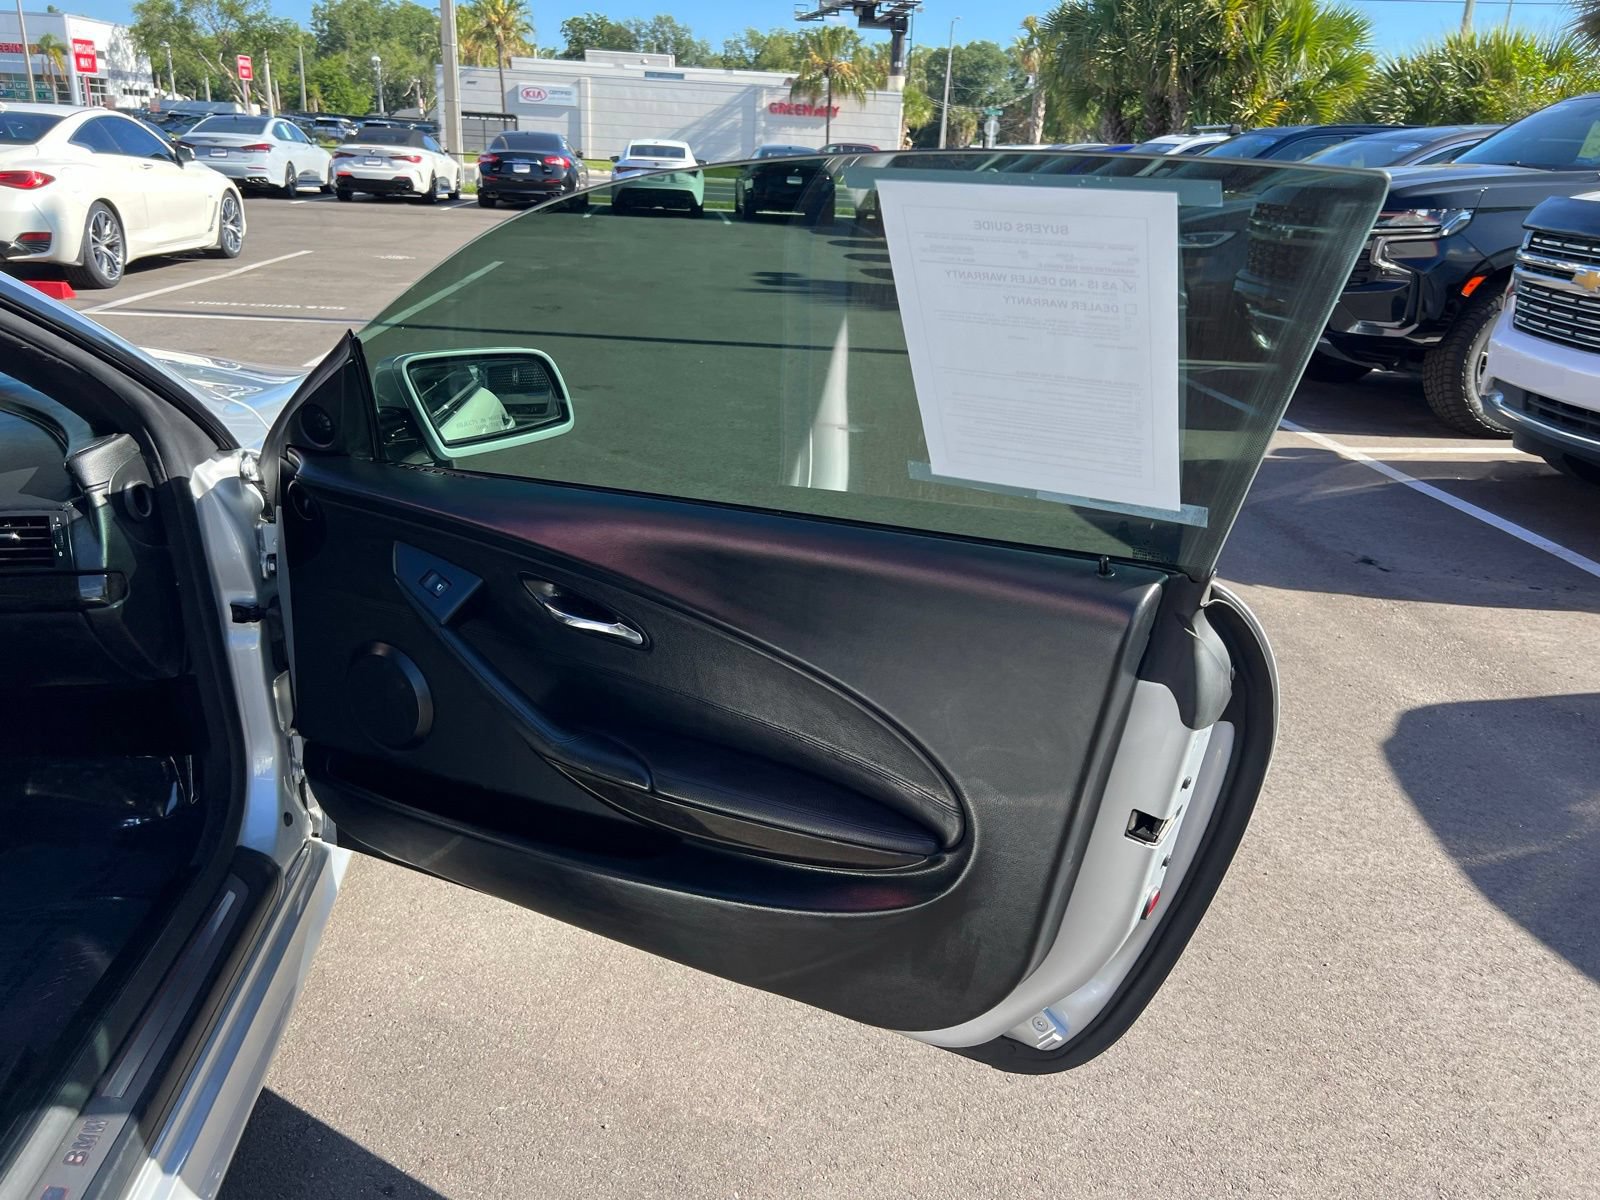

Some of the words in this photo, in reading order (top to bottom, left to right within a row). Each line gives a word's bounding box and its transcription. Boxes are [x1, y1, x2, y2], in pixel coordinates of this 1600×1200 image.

[74, 43, 95, 55] WRONG
[80, 58, 93, 67] WAY
[525, 90, 543, 99] KIA
[63, 1119, 108, 1167] BMW
